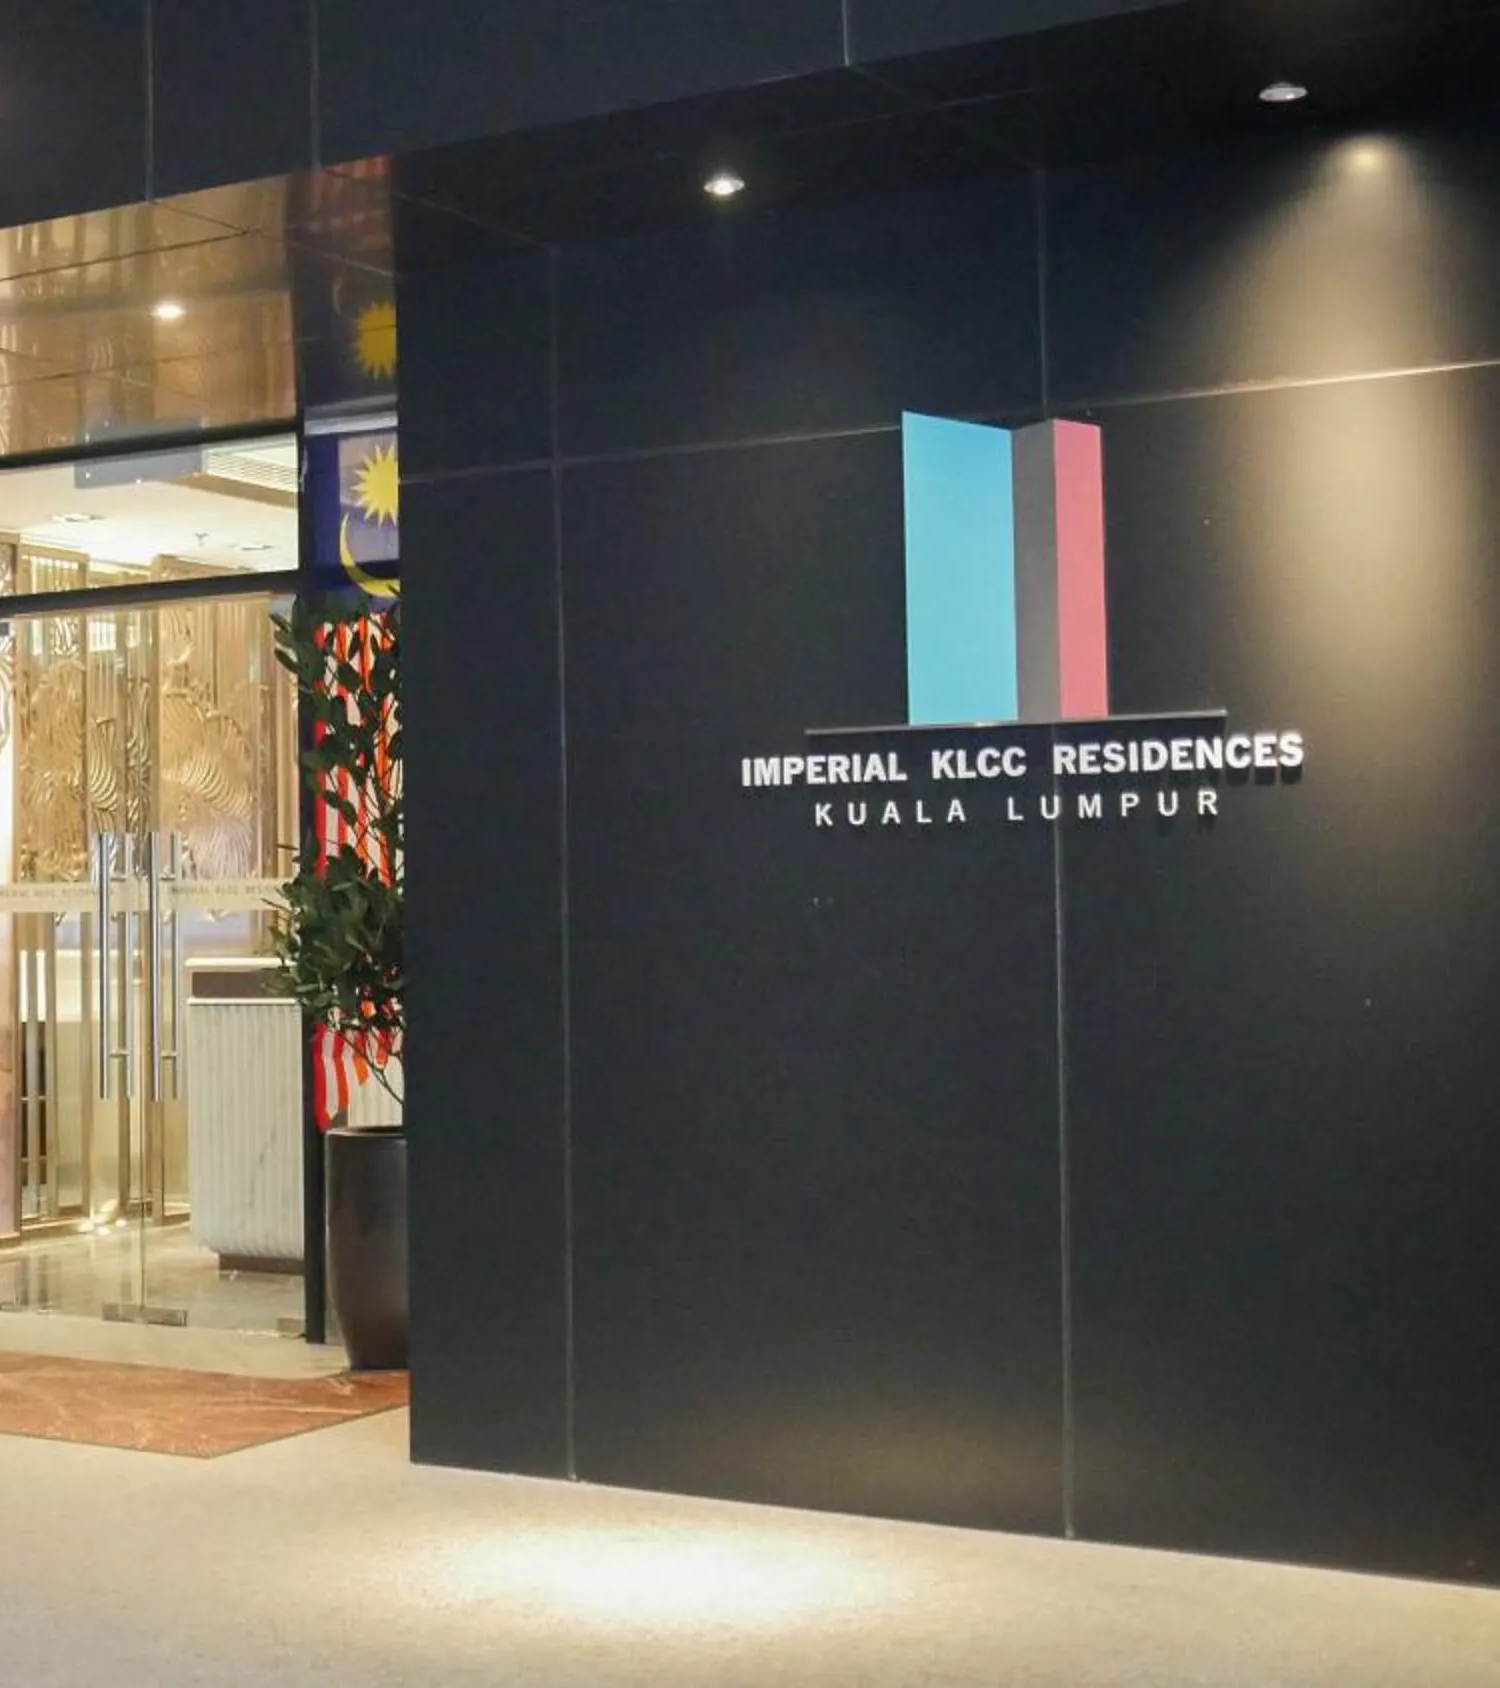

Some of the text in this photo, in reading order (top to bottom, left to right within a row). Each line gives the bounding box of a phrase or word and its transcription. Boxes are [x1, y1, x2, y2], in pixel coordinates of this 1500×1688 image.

[741, 731, 1305, 787] IMPERIAL KLCC RESIDENCES
[814, 787, 1219, 827] KUALA LUMPUR
